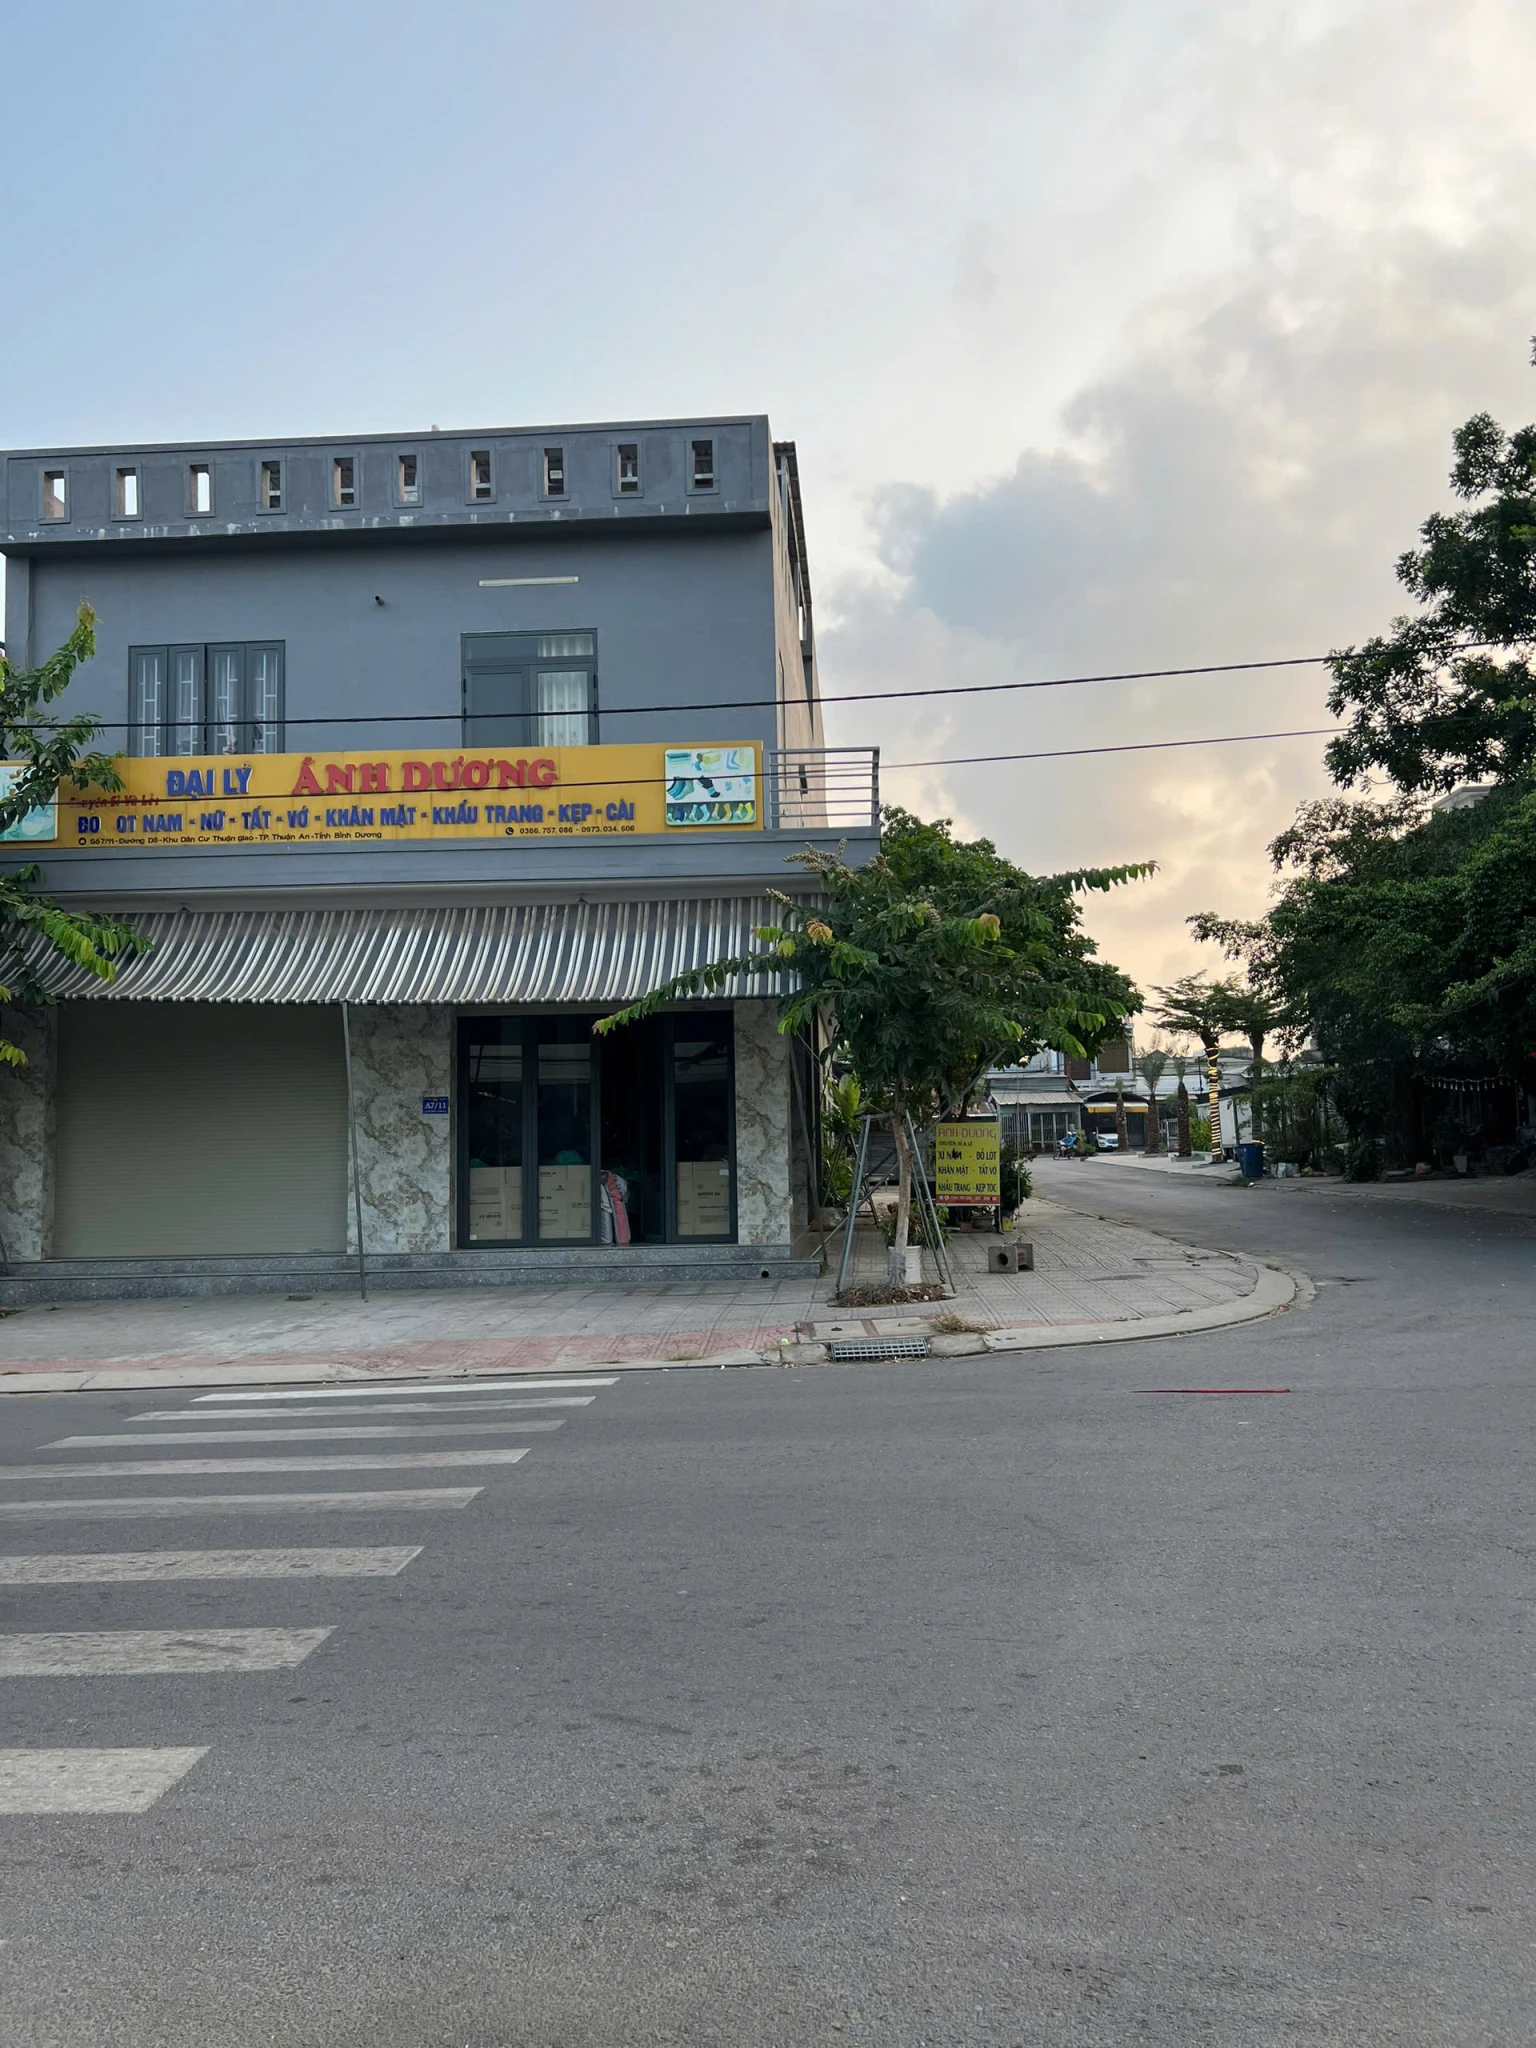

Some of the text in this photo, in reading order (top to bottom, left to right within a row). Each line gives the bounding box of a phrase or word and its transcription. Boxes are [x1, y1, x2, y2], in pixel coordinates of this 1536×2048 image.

[167, 763, 253, 800] ĐẠI LÝ
[291, 756, 558, 795] ÁNH DƯƠNG
[143, 813, 182, 832] NAM
[326, 804, 374, 827] KHĂN
[380, 803, 417, 828] MẶT
[485, 803, 543, 824] TRANG
[558, 802, 593, 825] KẸP
[425, 1102, 446, 1110] A7/11
[946, 1151, 962, 1160] NM
